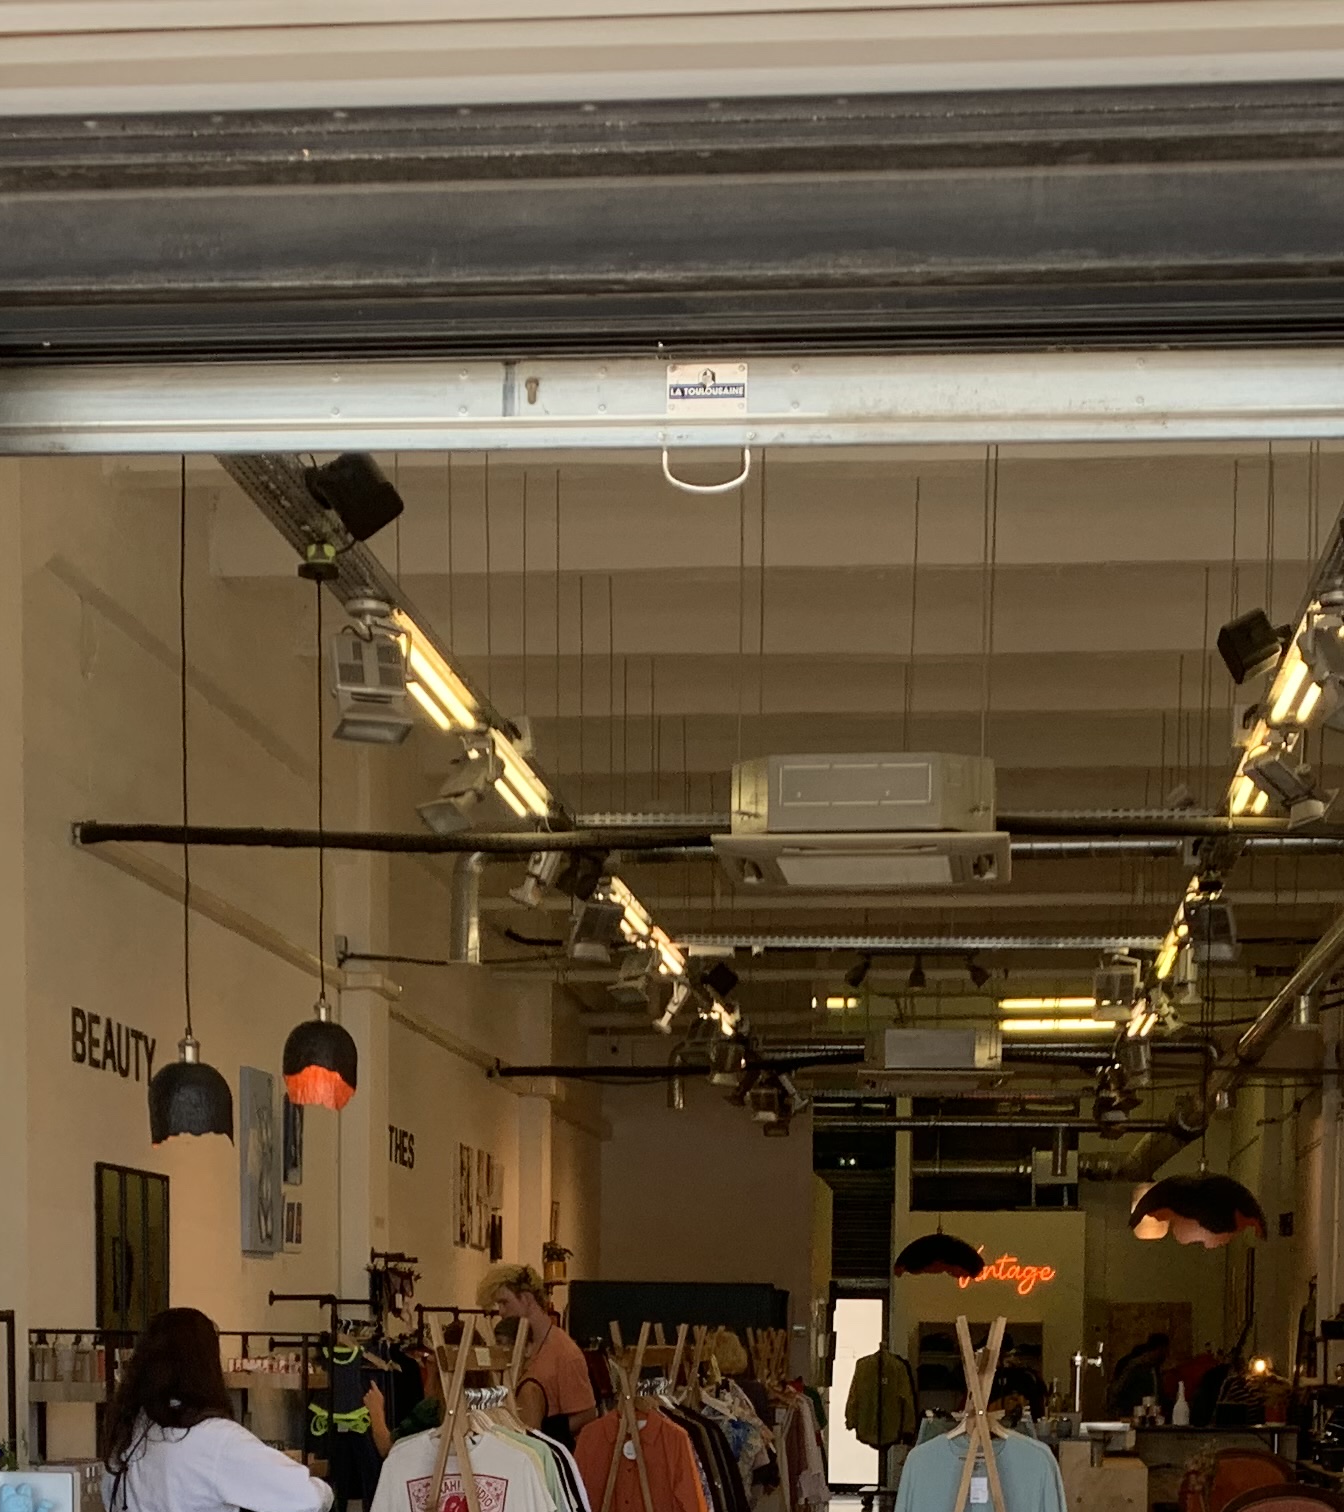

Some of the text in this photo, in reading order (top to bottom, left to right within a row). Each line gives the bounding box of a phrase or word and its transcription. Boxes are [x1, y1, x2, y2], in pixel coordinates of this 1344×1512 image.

[670, 386, 744, 396] LA TOULOUSAINE
[71, 1006, 157, 1086] BEAUTY
